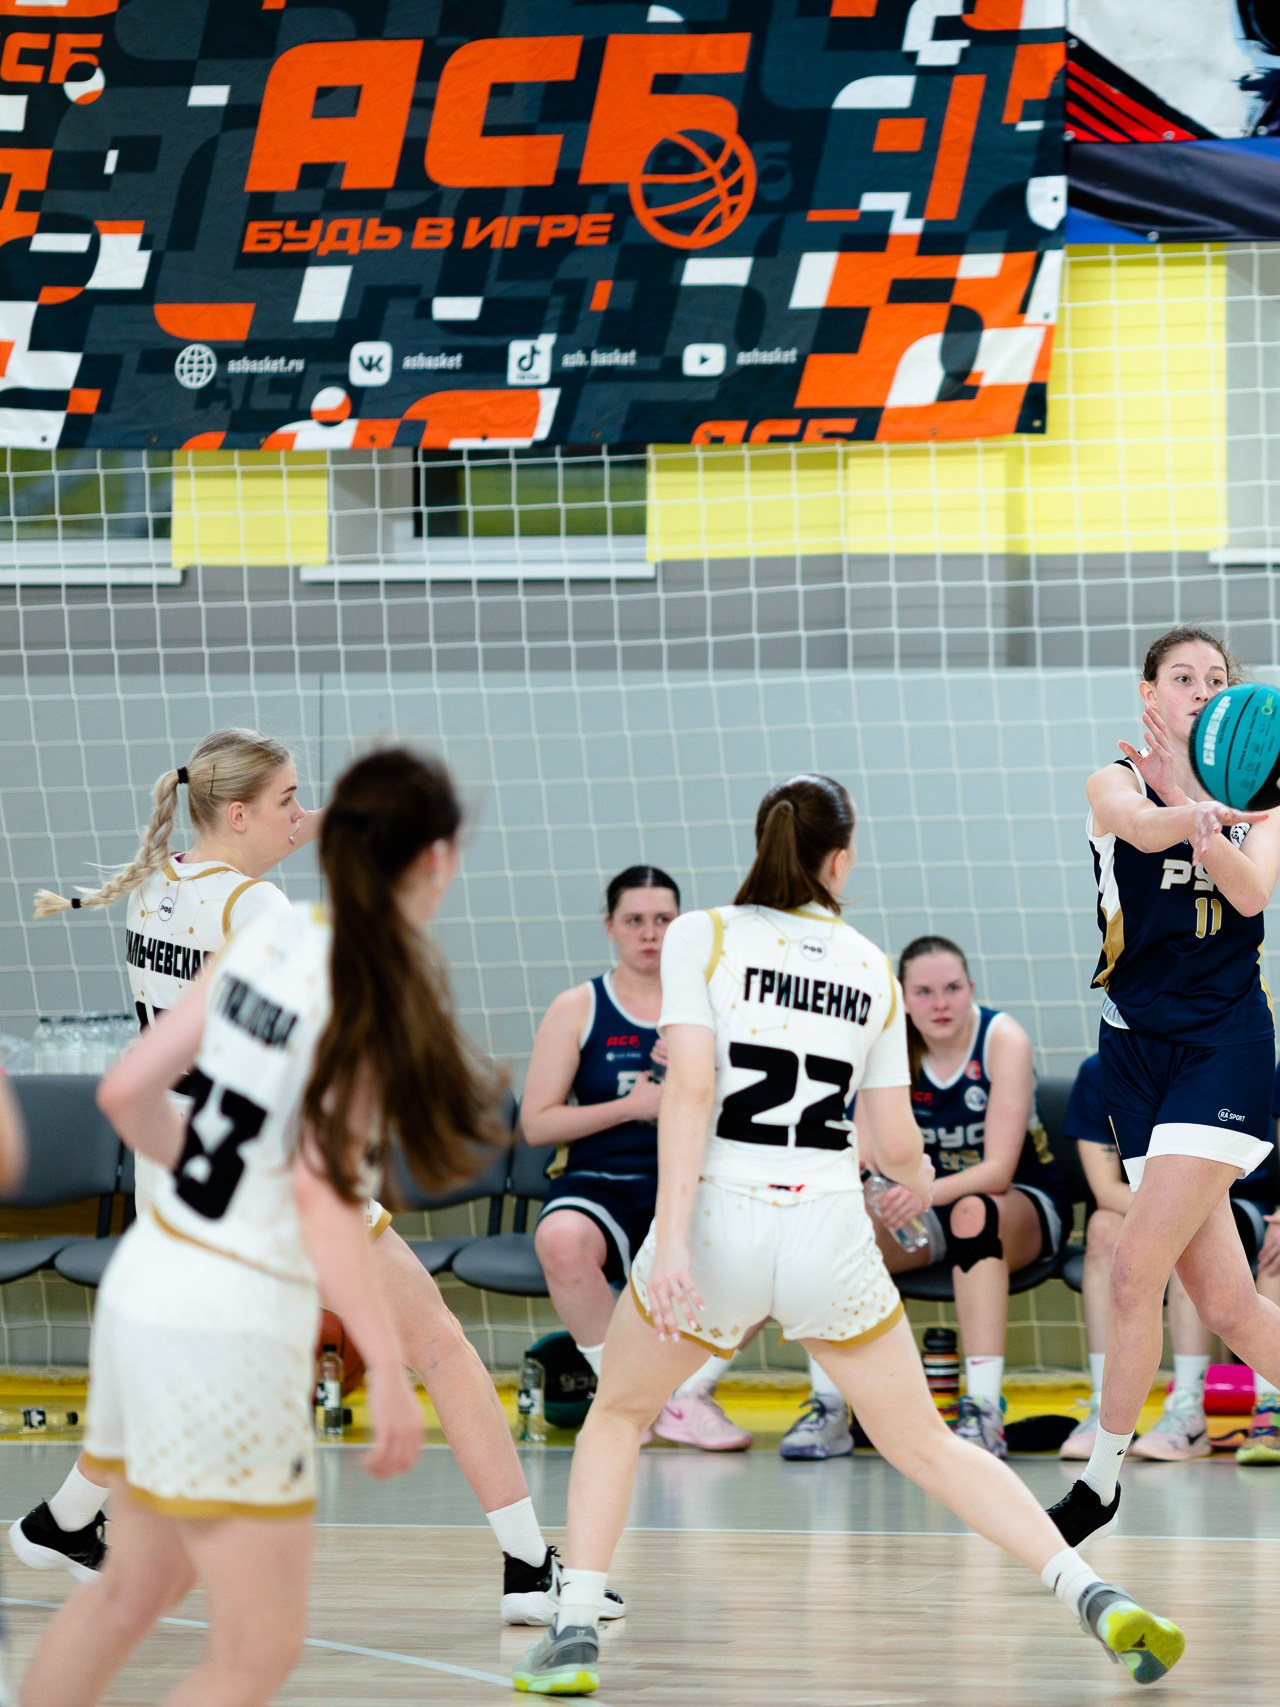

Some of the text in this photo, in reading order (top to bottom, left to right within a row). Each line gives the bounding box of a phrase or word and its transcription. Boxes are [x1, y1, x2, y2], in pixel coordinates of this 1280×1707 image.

[0, 31, 104, 84] СБ
[243, 32, 752, 192] АСБ
[242, 213, 615, 256] БУДЬ В ИГРЕ
[228, 356, 305, 374] asbasket.ru
[403, 352, 463, 370] asbasket
[1194, 897, 1222, 939] 11
[743, 966, 872, 1027] ГРИЦЕНКО
[716, 1041, 855, 1152] 22
